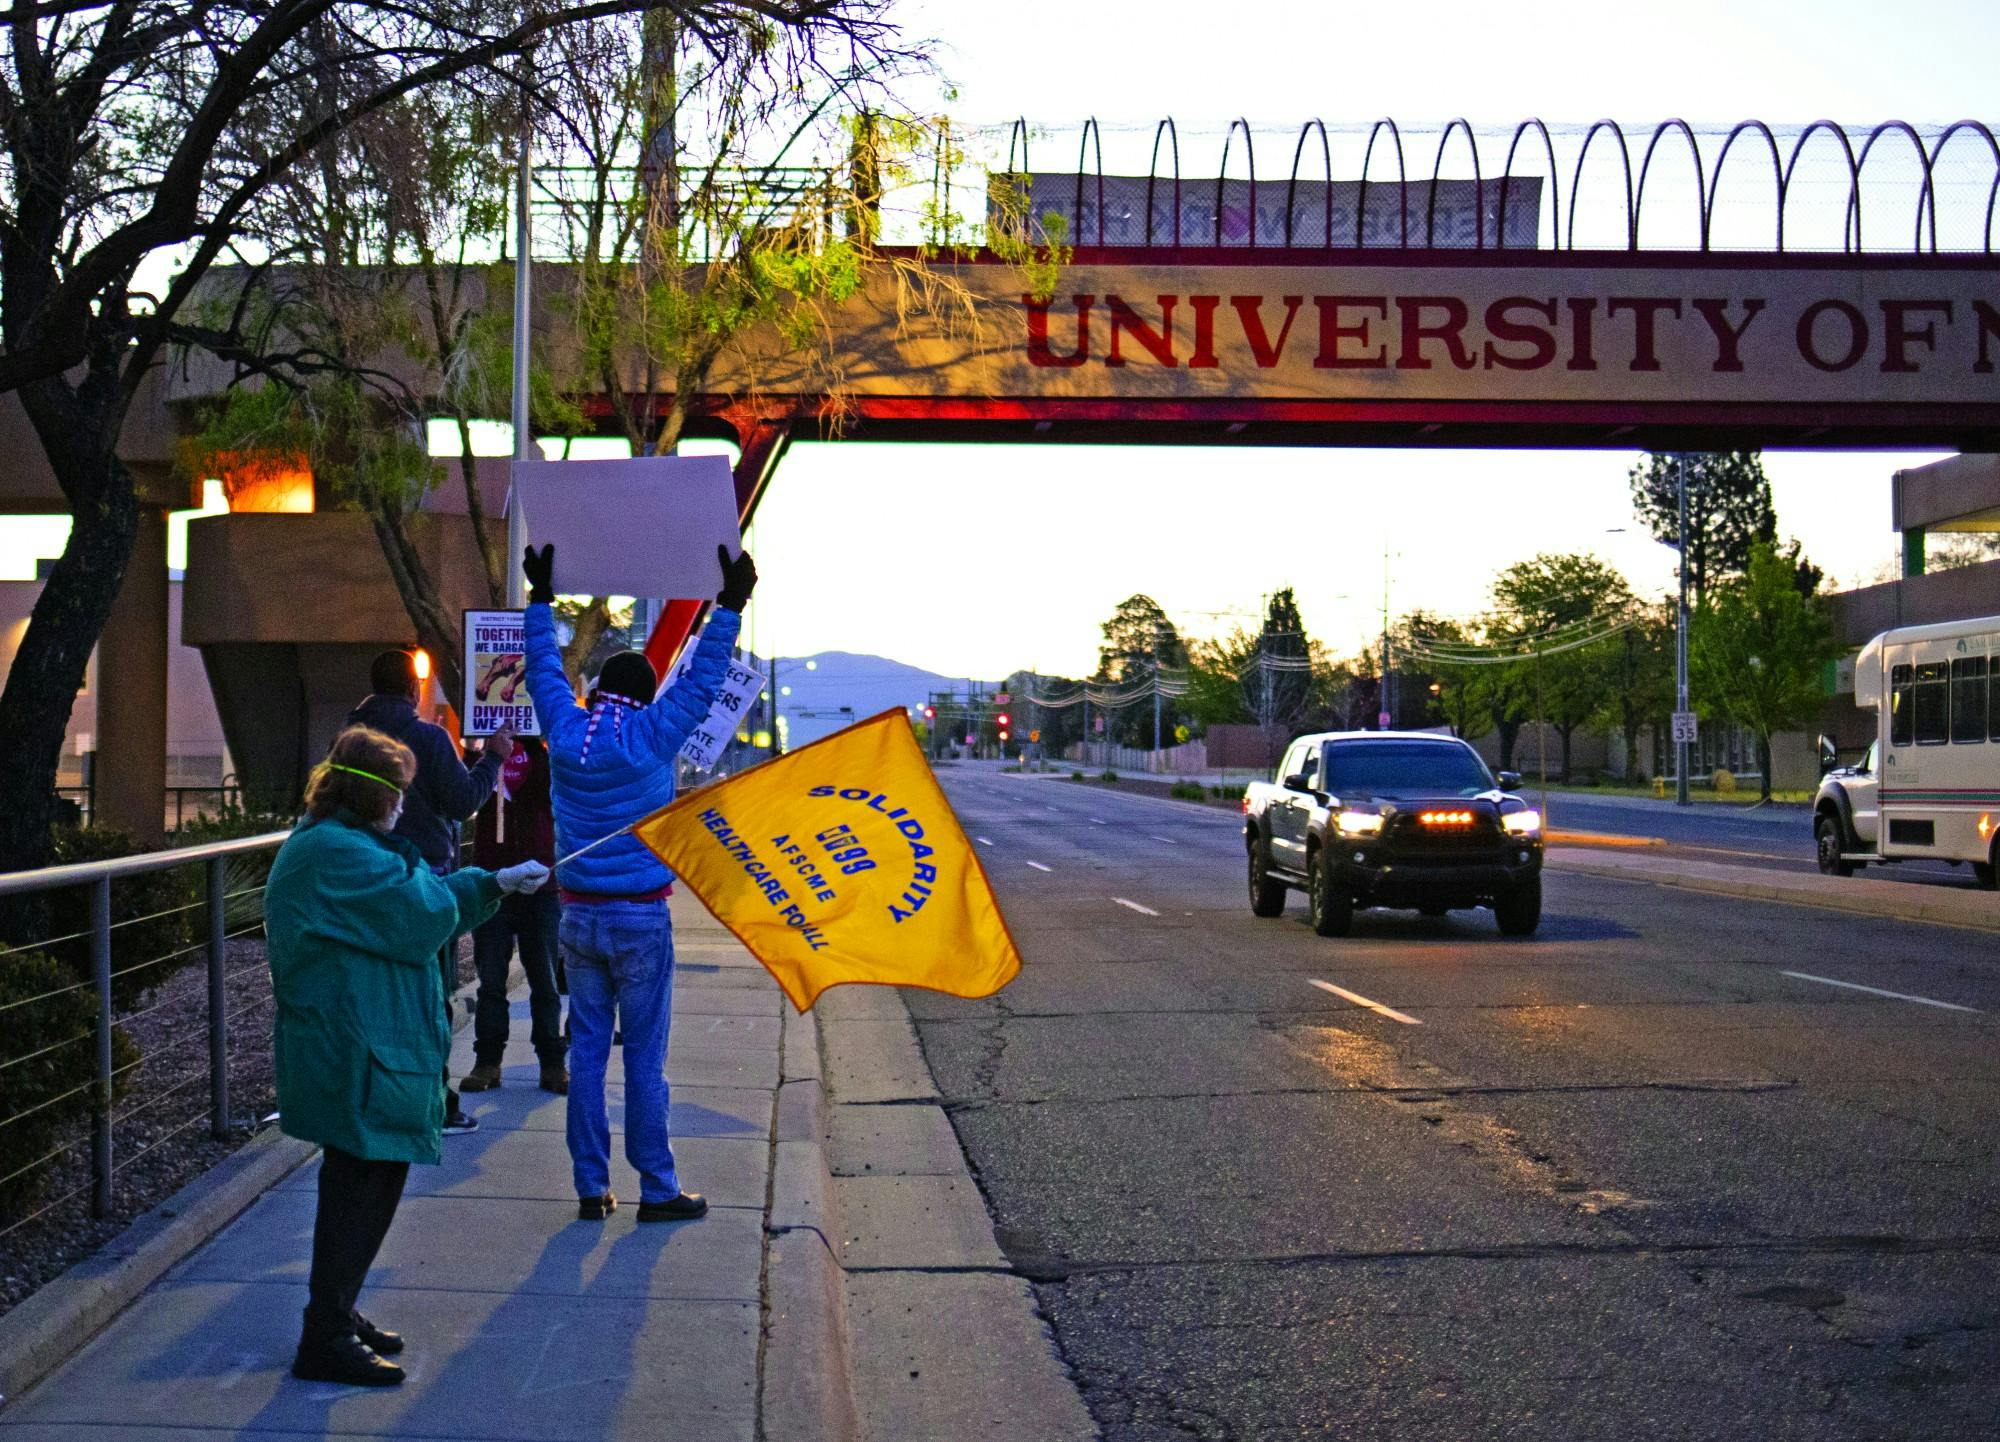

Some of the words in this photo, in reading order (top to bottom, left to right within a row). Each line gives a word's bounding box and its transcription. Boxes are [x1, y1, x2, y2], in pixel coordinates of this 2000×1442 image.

[1022, 294, 1766, 372] UNIVERSITY
[1796, 299, 1953, 372] OF
[475, 628, 525, 641] TOGETHE
[475, 643, 489, 652] WE
[493, 643, 525, 652] BARGA
[473, 705, 532, 718] DIVIDED
[473, 718, 498, 730] WE
[1676, 727, 1694, 740] 35
[807, 785, 937, 923] SOLIDARITY
[771, 834, 837, 903] AFSCME
